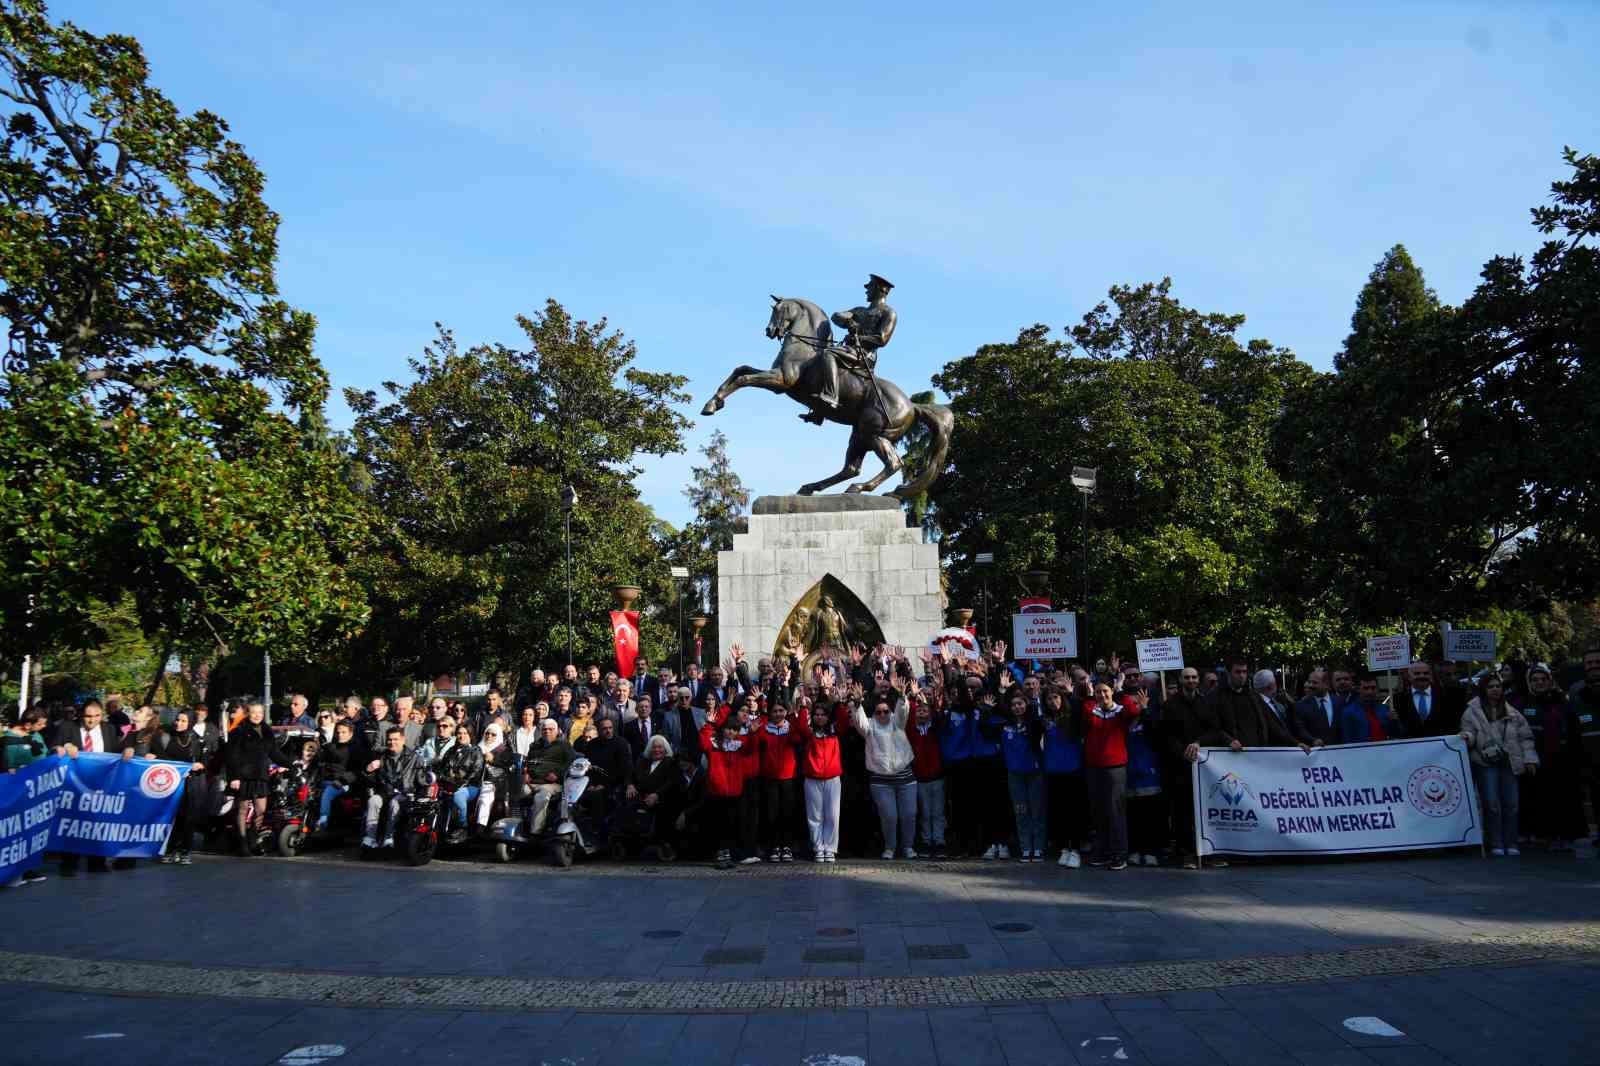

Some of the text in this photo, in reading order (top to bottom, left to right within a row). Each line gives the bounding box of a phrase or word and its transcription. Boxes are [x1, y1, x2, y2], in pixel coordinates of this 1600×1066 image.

[1302, 766, 1344, 783] PERA
[25, 779, 35, 799] 3
[1259, 786, 1404, 809] DEĞERLİ HAYATLAR
[79, 789, 127, 815] GÜNÜ
[1208, 807, 1258, 821] PERA
[1277, 806, 1396, 834] BAKIM MERKEZİ
